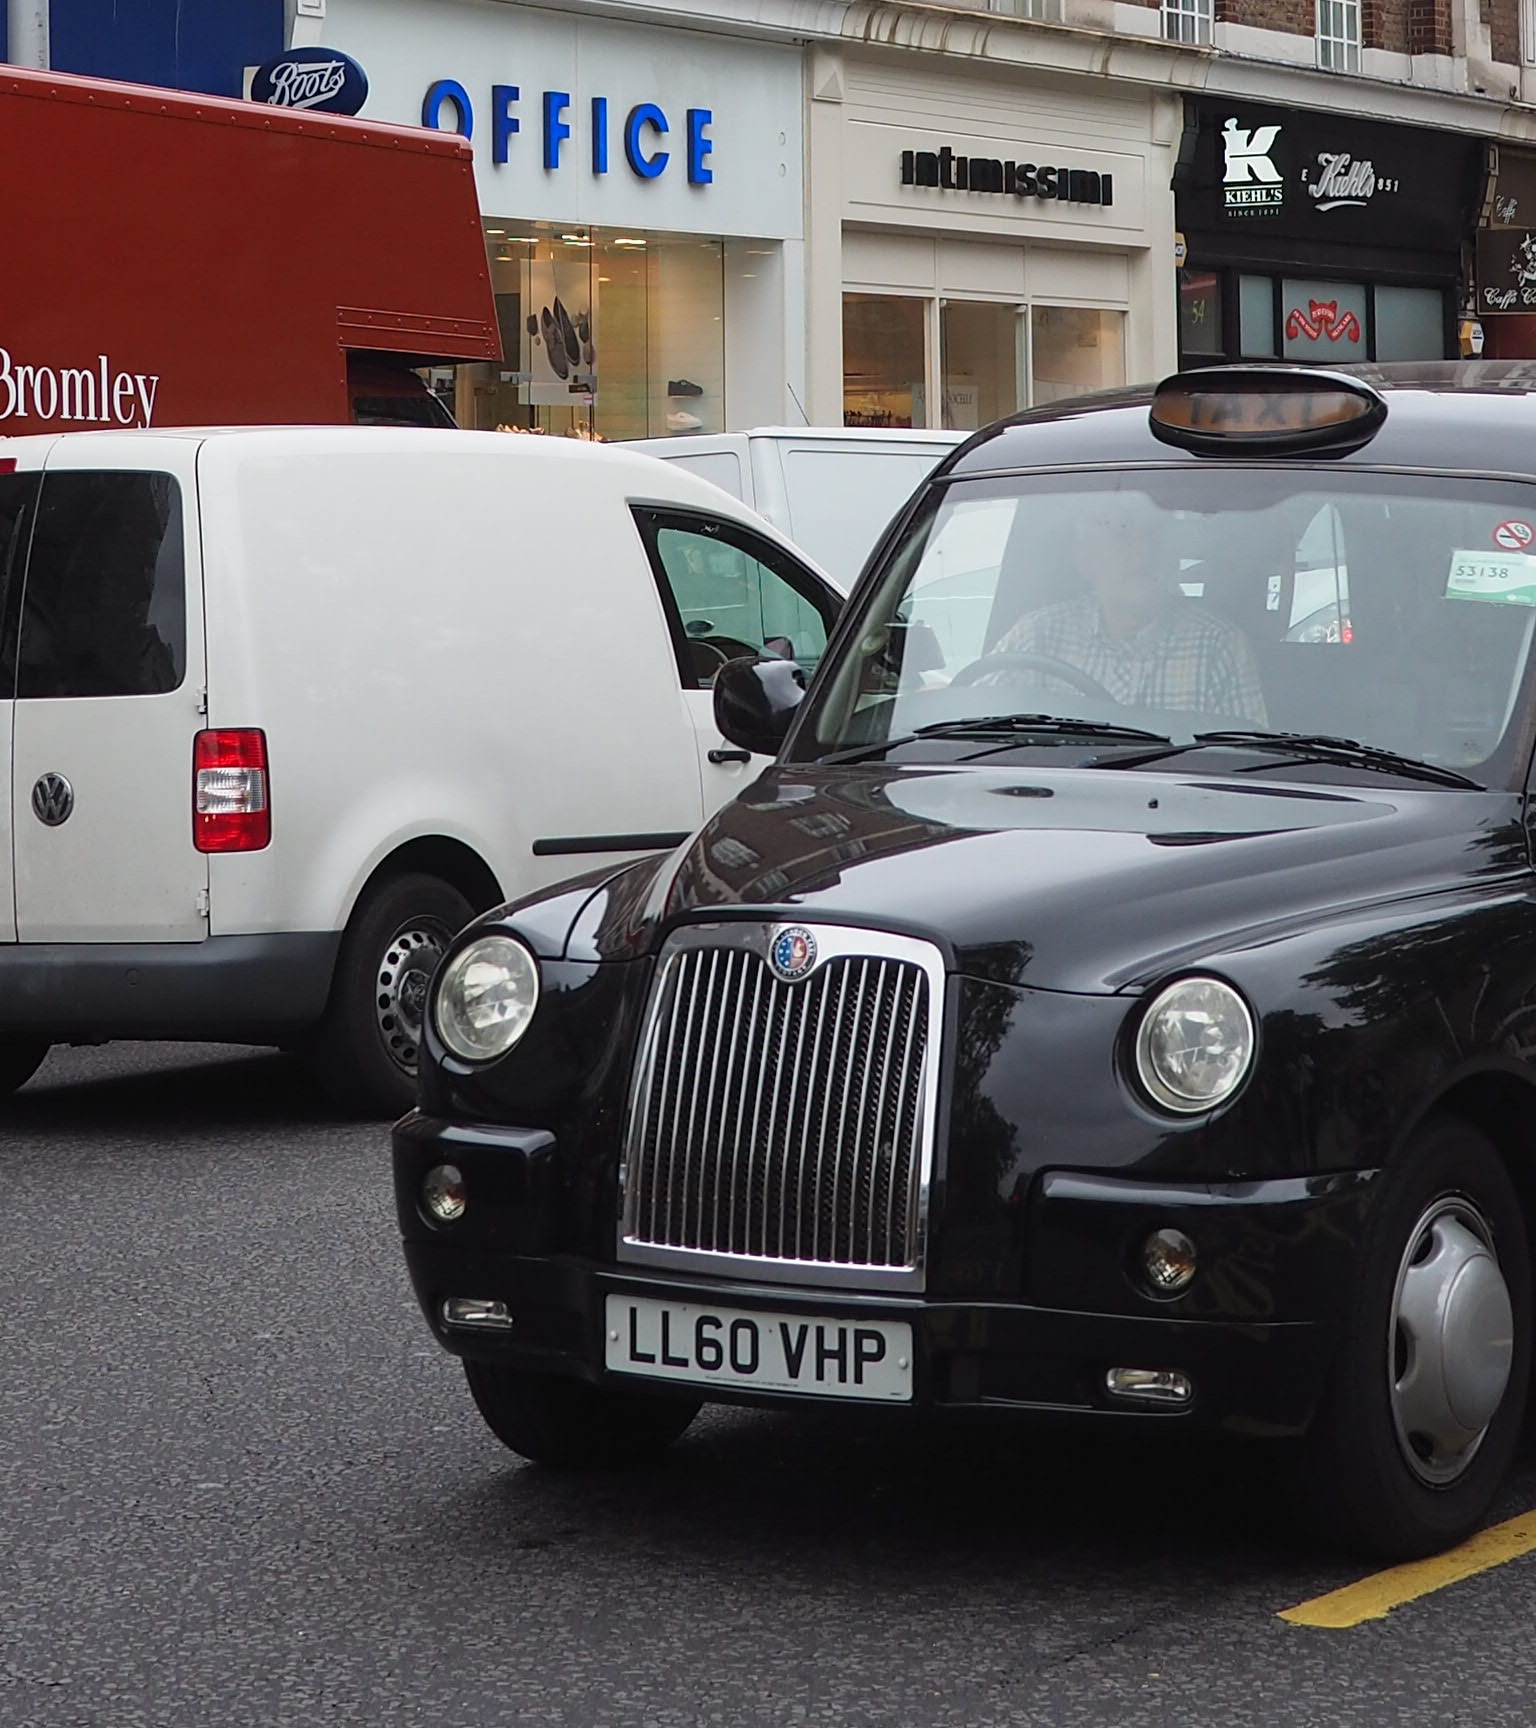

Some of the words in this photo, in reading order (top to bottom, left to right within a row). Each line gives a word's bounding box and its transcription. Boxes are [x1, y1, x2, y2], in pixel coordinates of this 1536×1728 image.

[421, 78, 713, 184] OFFICE
[1308, 152, 1377, 199] Kiehl's
[1224, 188, 1284, 204] KIEHL'S
[1186, 393, 1315, 425] TAXI
[1455, 565, 1510, 579] 53138
[628, 1306, 759, 1375] LL60
[778, 1321, 886, 1384] VHP
